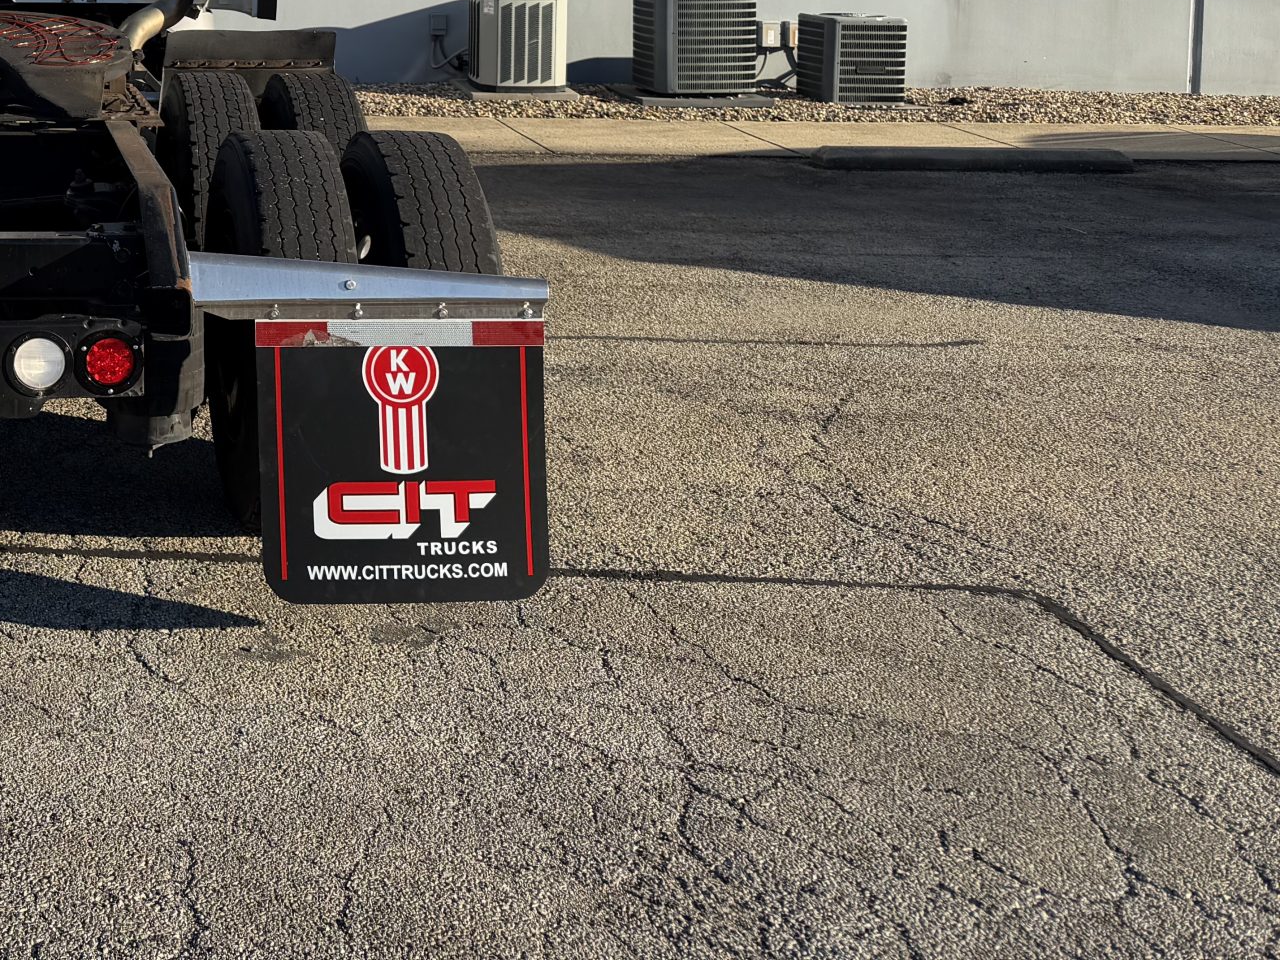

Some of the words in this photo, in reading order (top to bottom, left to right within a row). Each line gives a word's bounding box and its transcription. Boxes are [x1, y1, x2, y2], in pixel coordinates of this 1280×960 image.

[390, 349, 409, 372] K
[385, 372, 416, 395] W
[313, 480, 496, 540] CIT
[417, 541, 498, 556] TRUCKS
[307, 562, 508, 581] WWW.CITTRUCKS.COM
